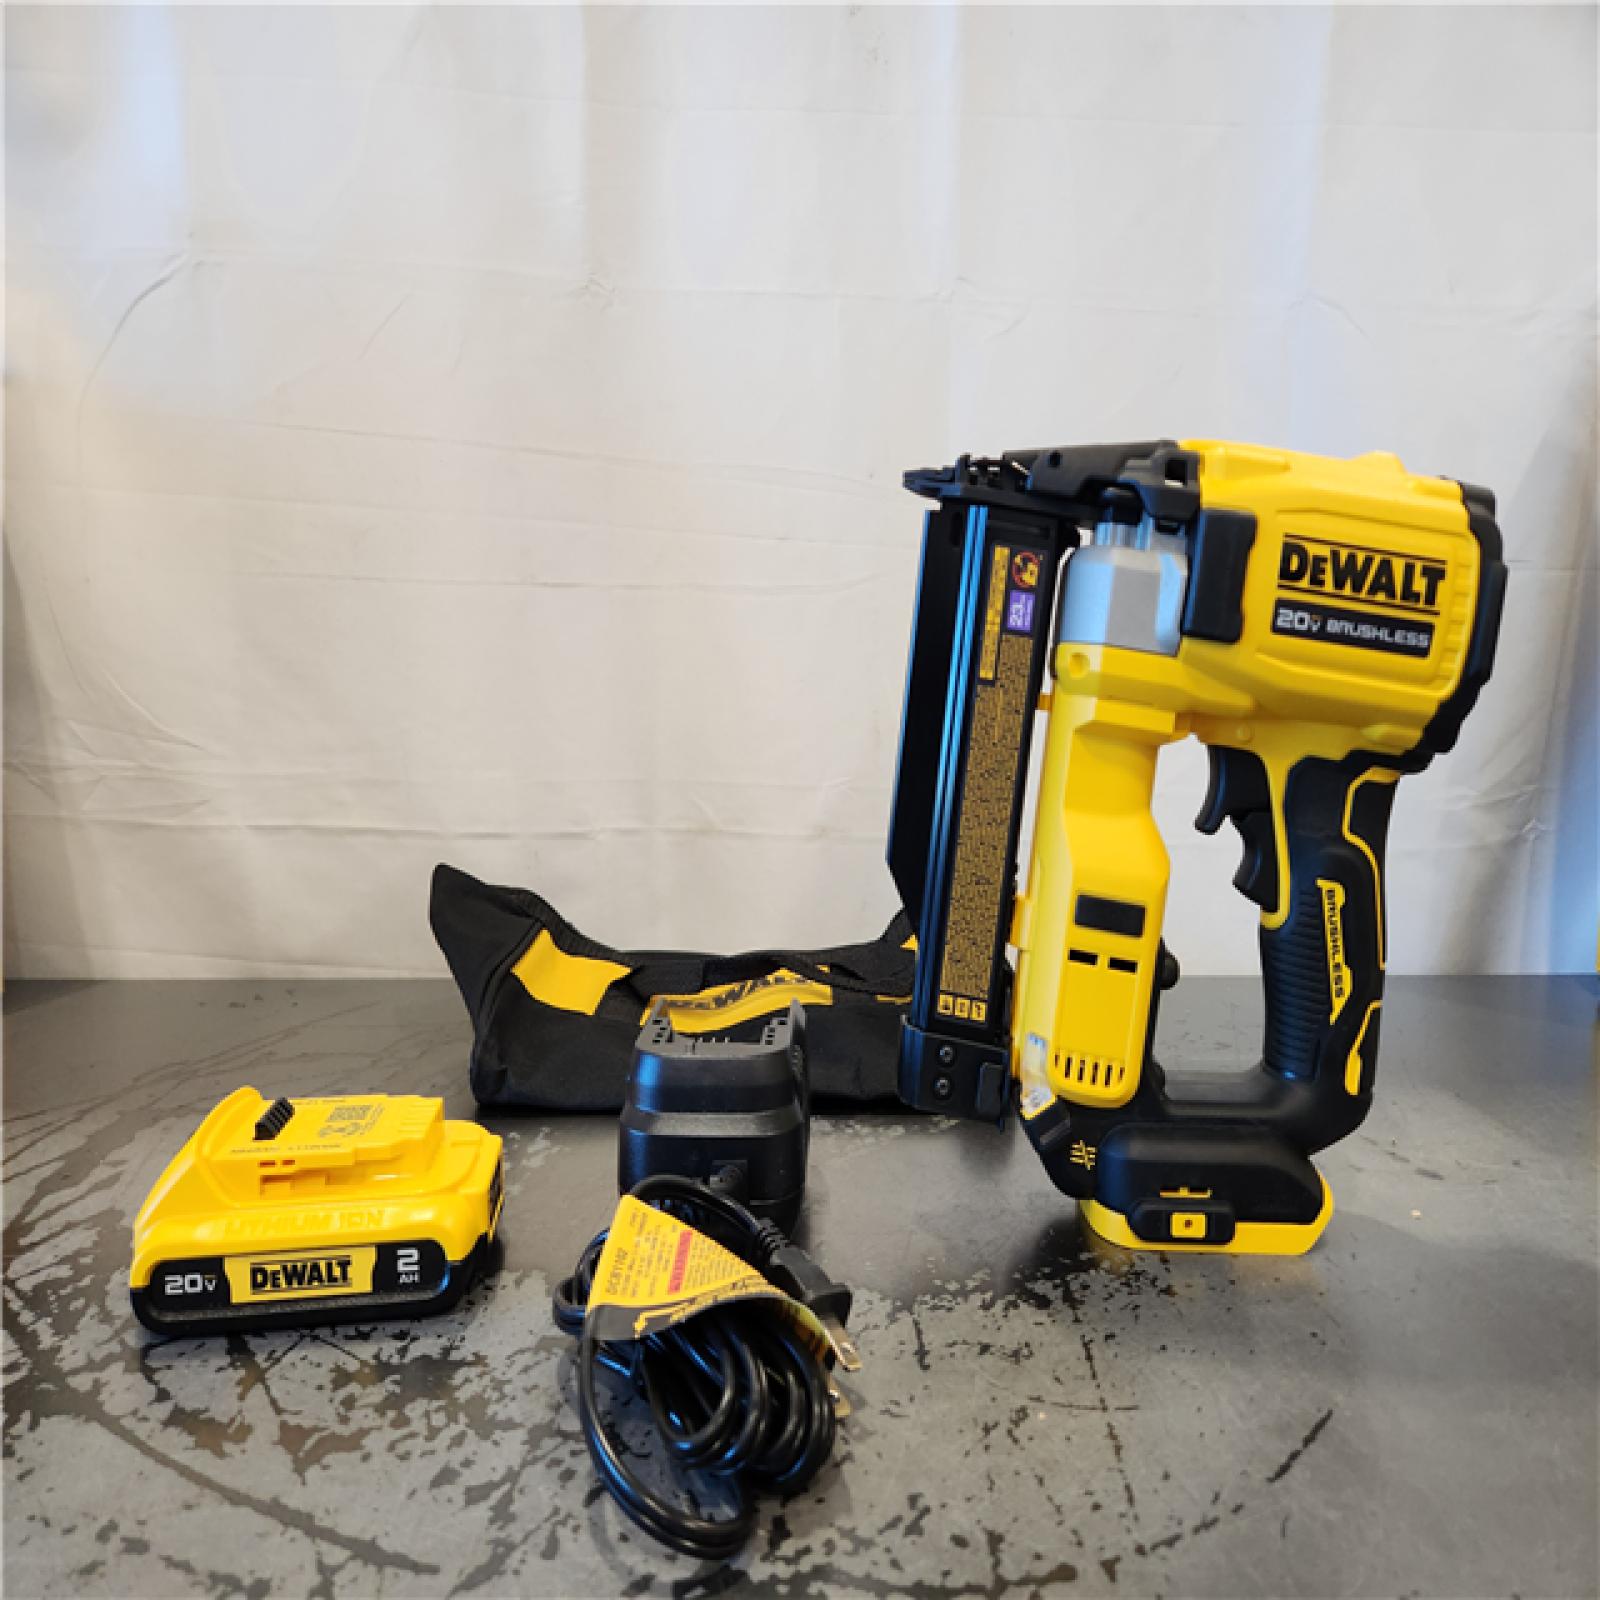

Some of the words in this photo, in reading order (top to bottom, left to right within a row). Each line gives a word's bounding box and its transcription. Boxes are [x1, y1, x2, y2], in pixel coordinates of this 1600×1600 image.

[1326, 619, 1430, 648] BRUSHLESS
[1326, 889, 1346, 998] BRUSHLESS
[397, 1248, 420, 1271] 2
